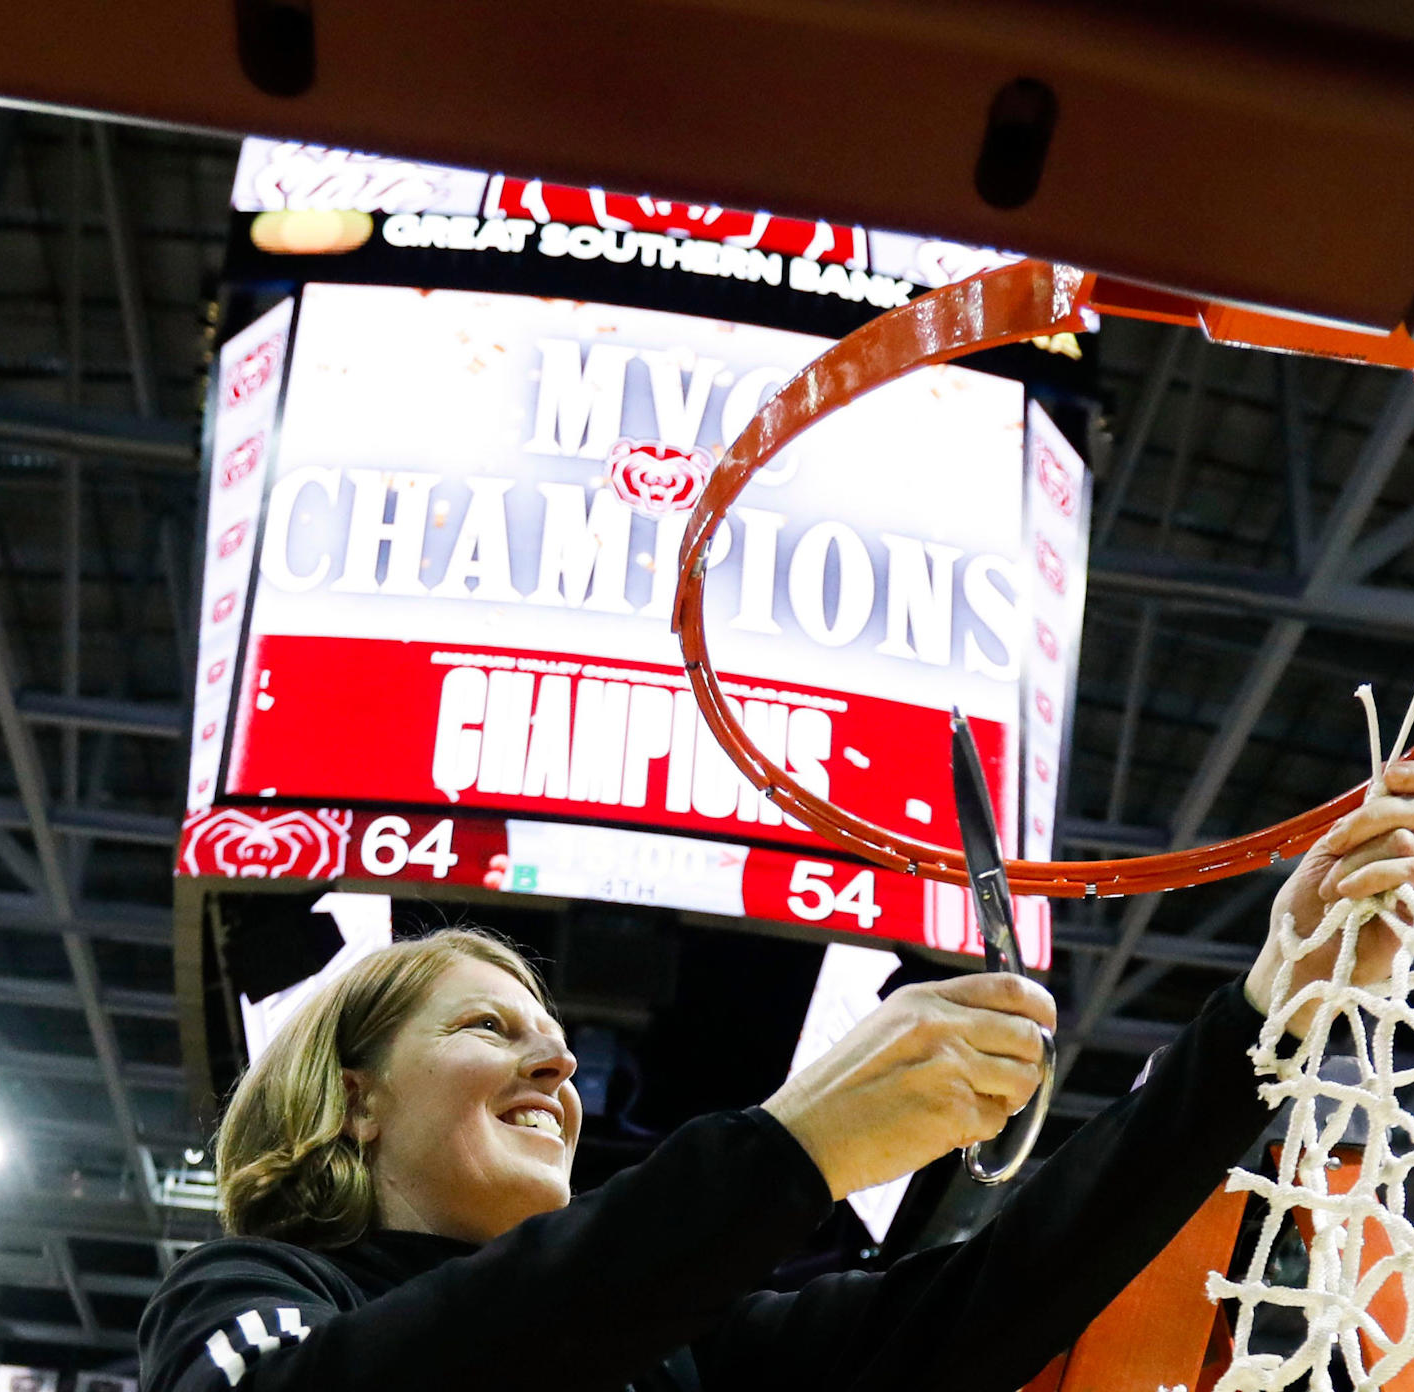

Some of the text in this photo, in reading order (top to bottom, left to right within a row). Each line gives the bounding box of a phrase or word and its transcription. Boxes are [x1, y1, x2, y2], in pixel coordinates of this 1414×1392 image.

[382, 213, 536, 253] GREAT
[539, 222, 783, 286] SOUTHERN
[789, 256, 914, 308] BANK
[258, 465, 1020, 683] CHAMPIONS
[432, 667, 833, 831] CHAMPIONS
[361, 815, 459, 879] 64
[787, 859, 882, 929] 54
